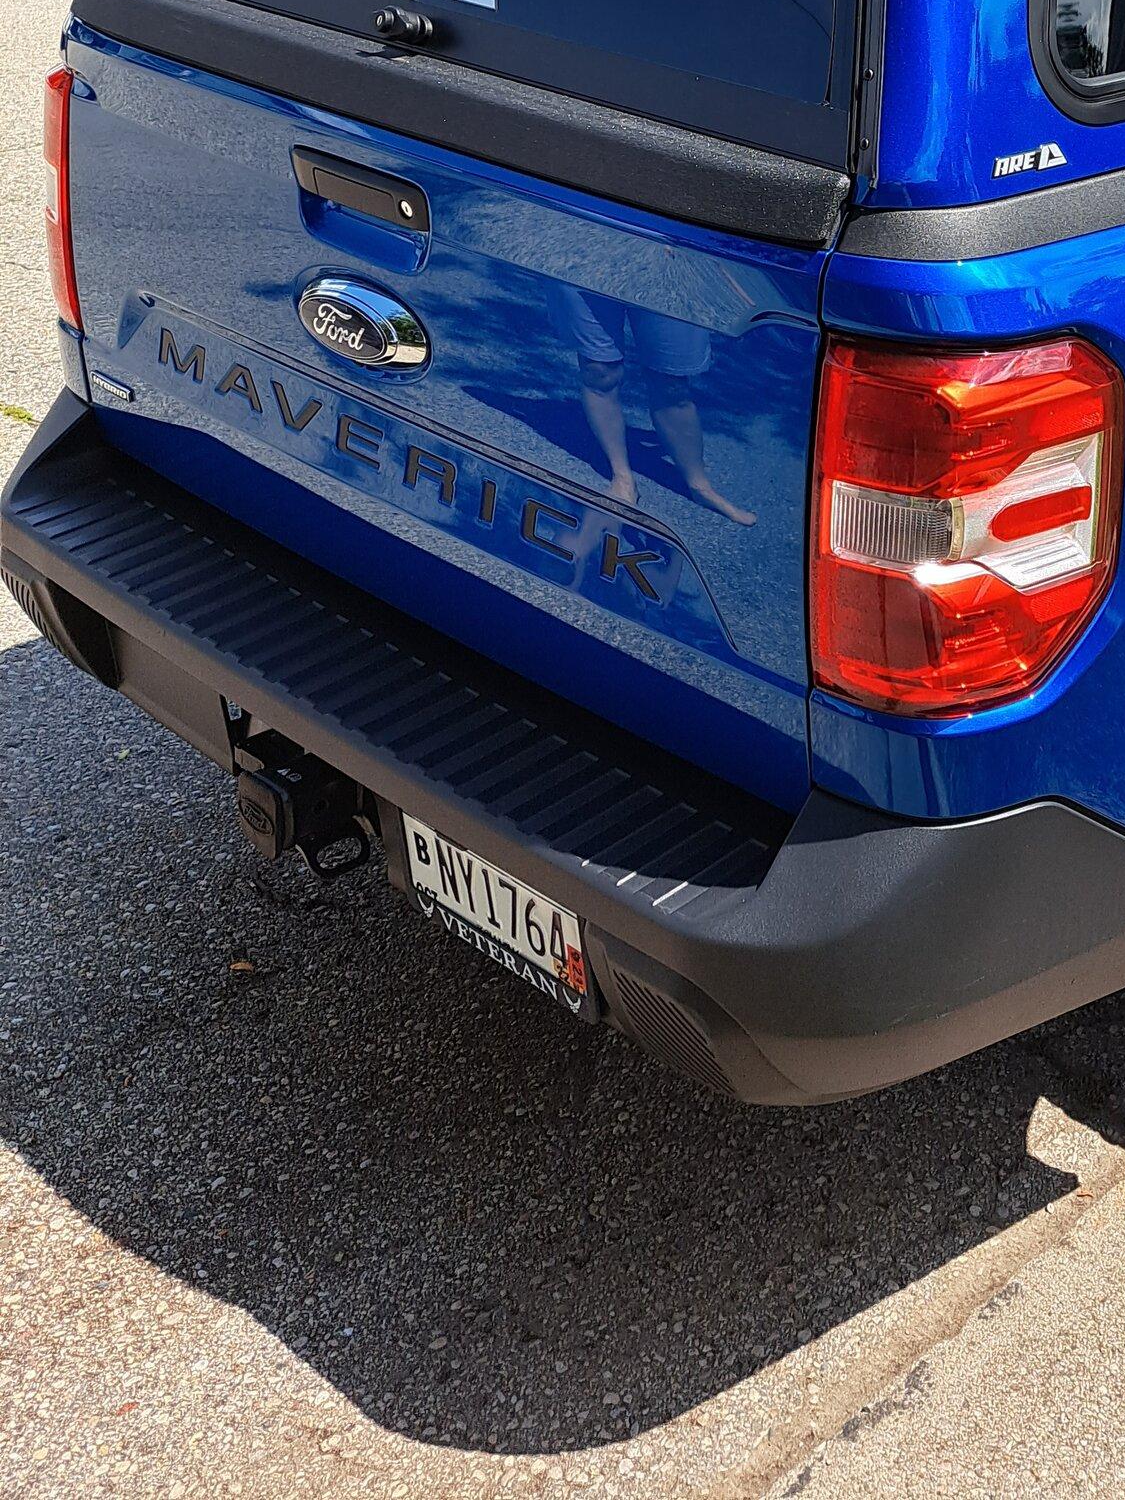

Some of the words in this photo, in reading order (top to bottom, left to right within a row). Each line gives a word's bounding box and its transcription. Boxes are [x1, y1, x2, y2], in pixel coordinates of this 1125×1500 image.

[312, 303, 365, 351] Ford
[92, 374, 128, 399] HYBRID
[158, 327, 664, 603] MAVERICK
[436, 905, 558, 1001] VETERAN
